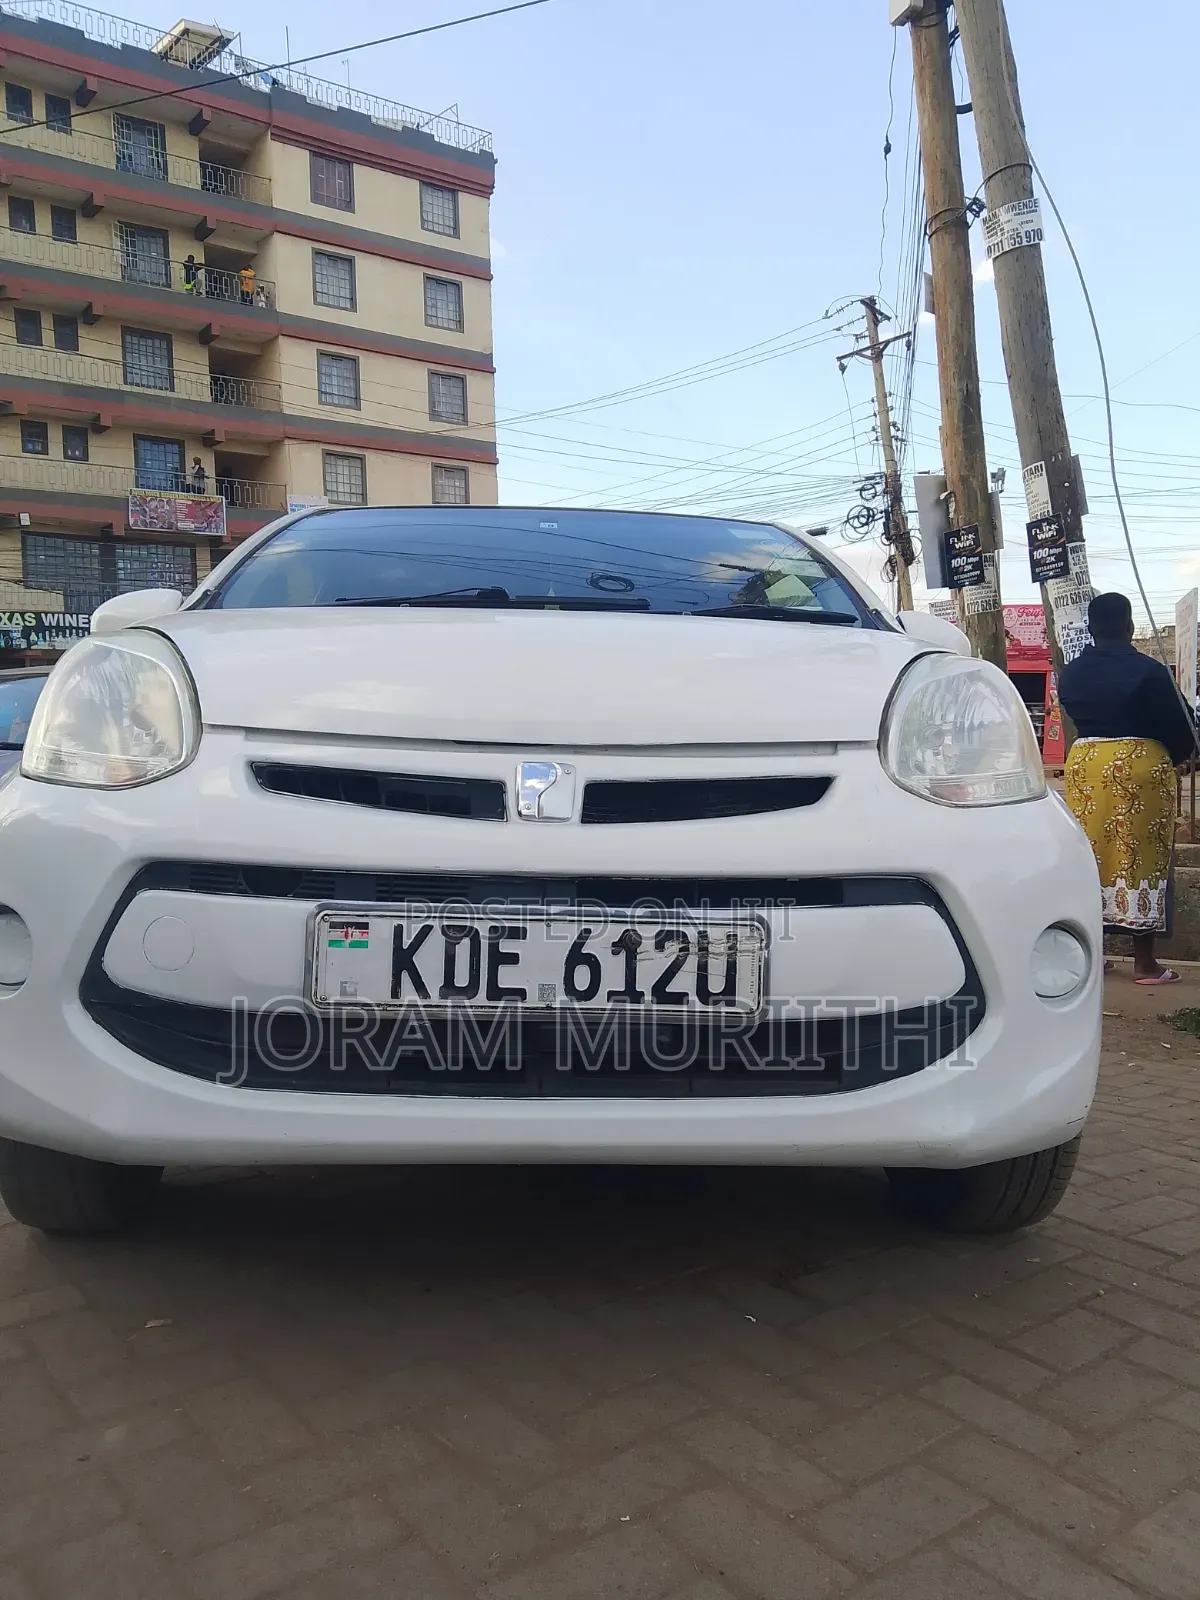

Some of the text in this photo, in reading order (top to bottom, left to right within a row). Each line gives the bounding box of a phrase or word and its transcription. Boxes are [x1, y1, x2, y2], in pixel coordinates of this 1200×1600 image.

[982, 207, 1003, 227] MAMA
[1003, 199, 1039, 216] MWENDE
[986, 238, 1005, 258] 0711
[1004, 231, 1023, 250] 155
[1024, 228, 1043, 243] 970
[950, 533, 976, 544] FLINK
[951, 556, 967, 568] 100
[1033, 548, 1049, 560] 100
[966, 601, 980, 614] 0722
[980, 600, 993, 612] 626
[1055, 594, 1070, 609] 0722
[1070, 591, 1083, 605] 626
[41, 612, 92, 628] WINE
[390, 922, 738, 1007] KDE 612U
